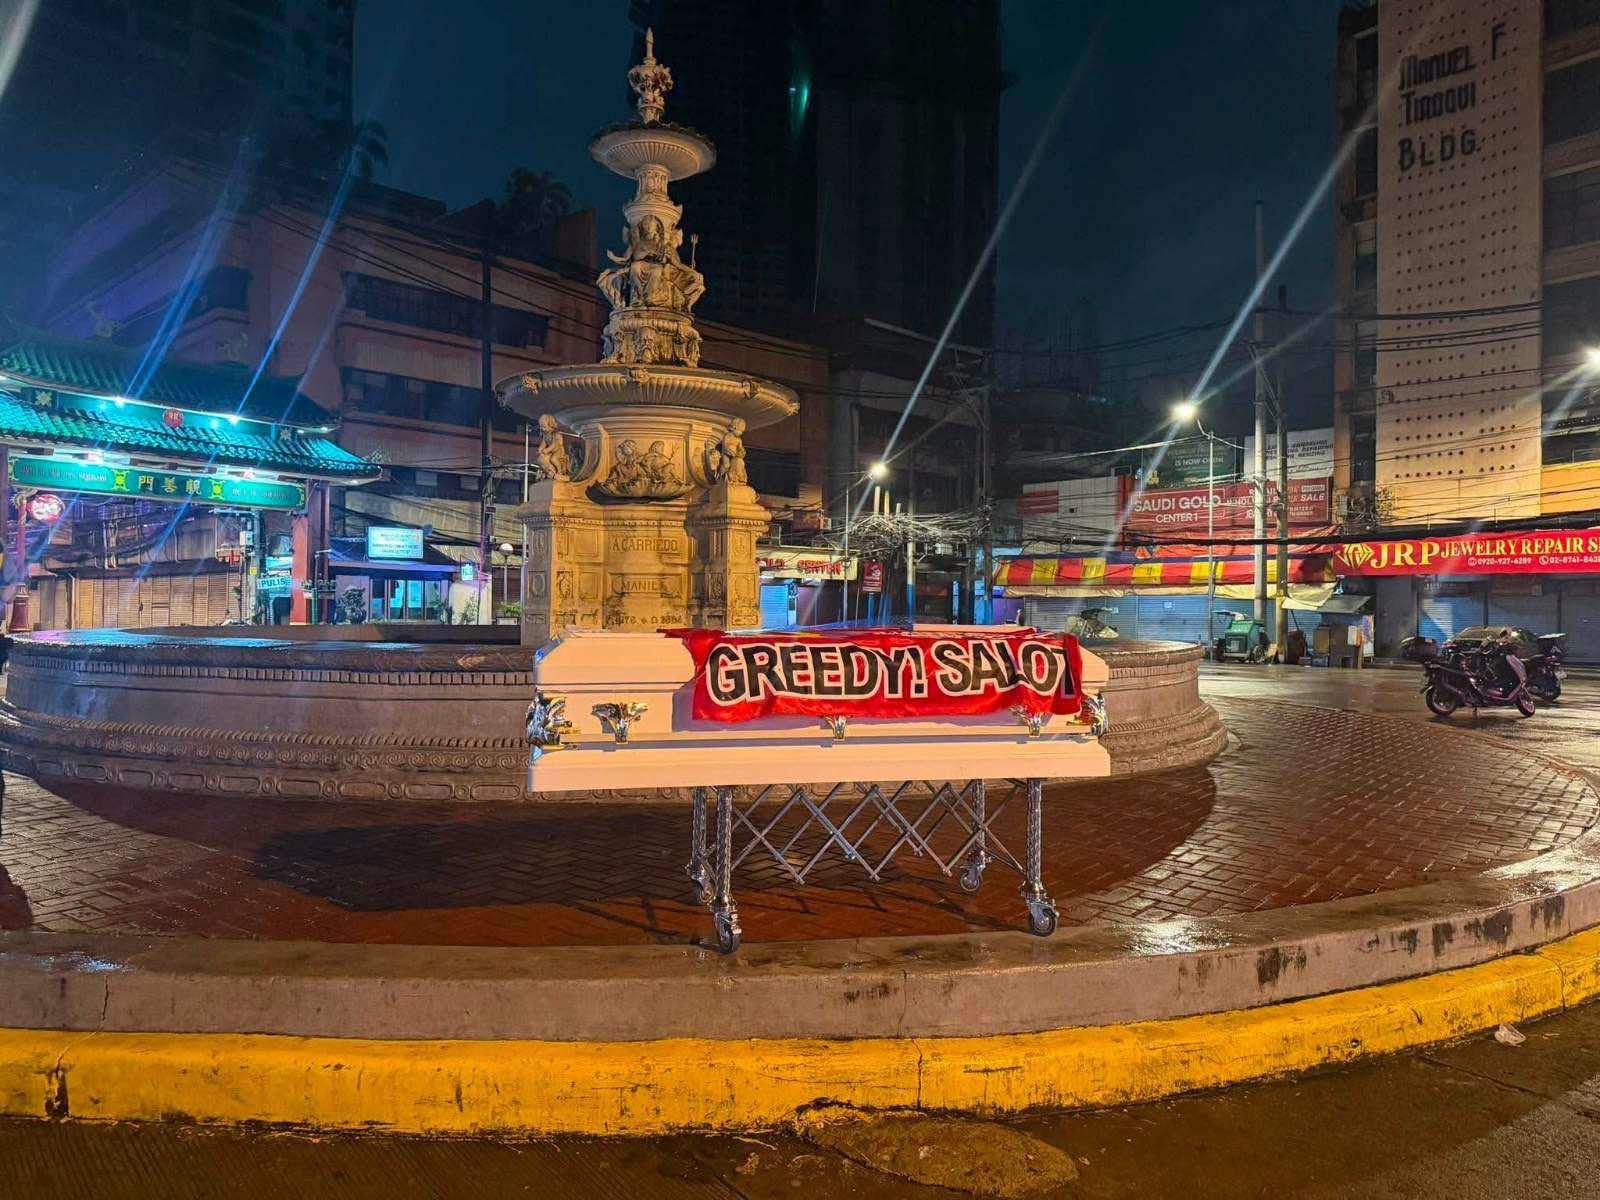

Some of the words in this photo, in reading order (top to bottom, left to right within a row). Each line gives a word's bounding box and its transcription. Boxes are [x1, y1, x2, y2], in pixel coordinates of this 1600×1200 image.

[1182, 457, 1201, 466] NOW
[1201, 456, 1224, 464] OEN
[1134, 498, 1176, 512] SAUDI
[1178, 495, 1221, 510] GOLD
[1300, 493, 1325, 502] SALE
[1155, 513, 1193, 523] CENTER
[1441, 538, 1517, 558] JEWELRY
[1521, 537, 1584, 555] REPAIR
[706, 643, 928, 706] GREEDY!
